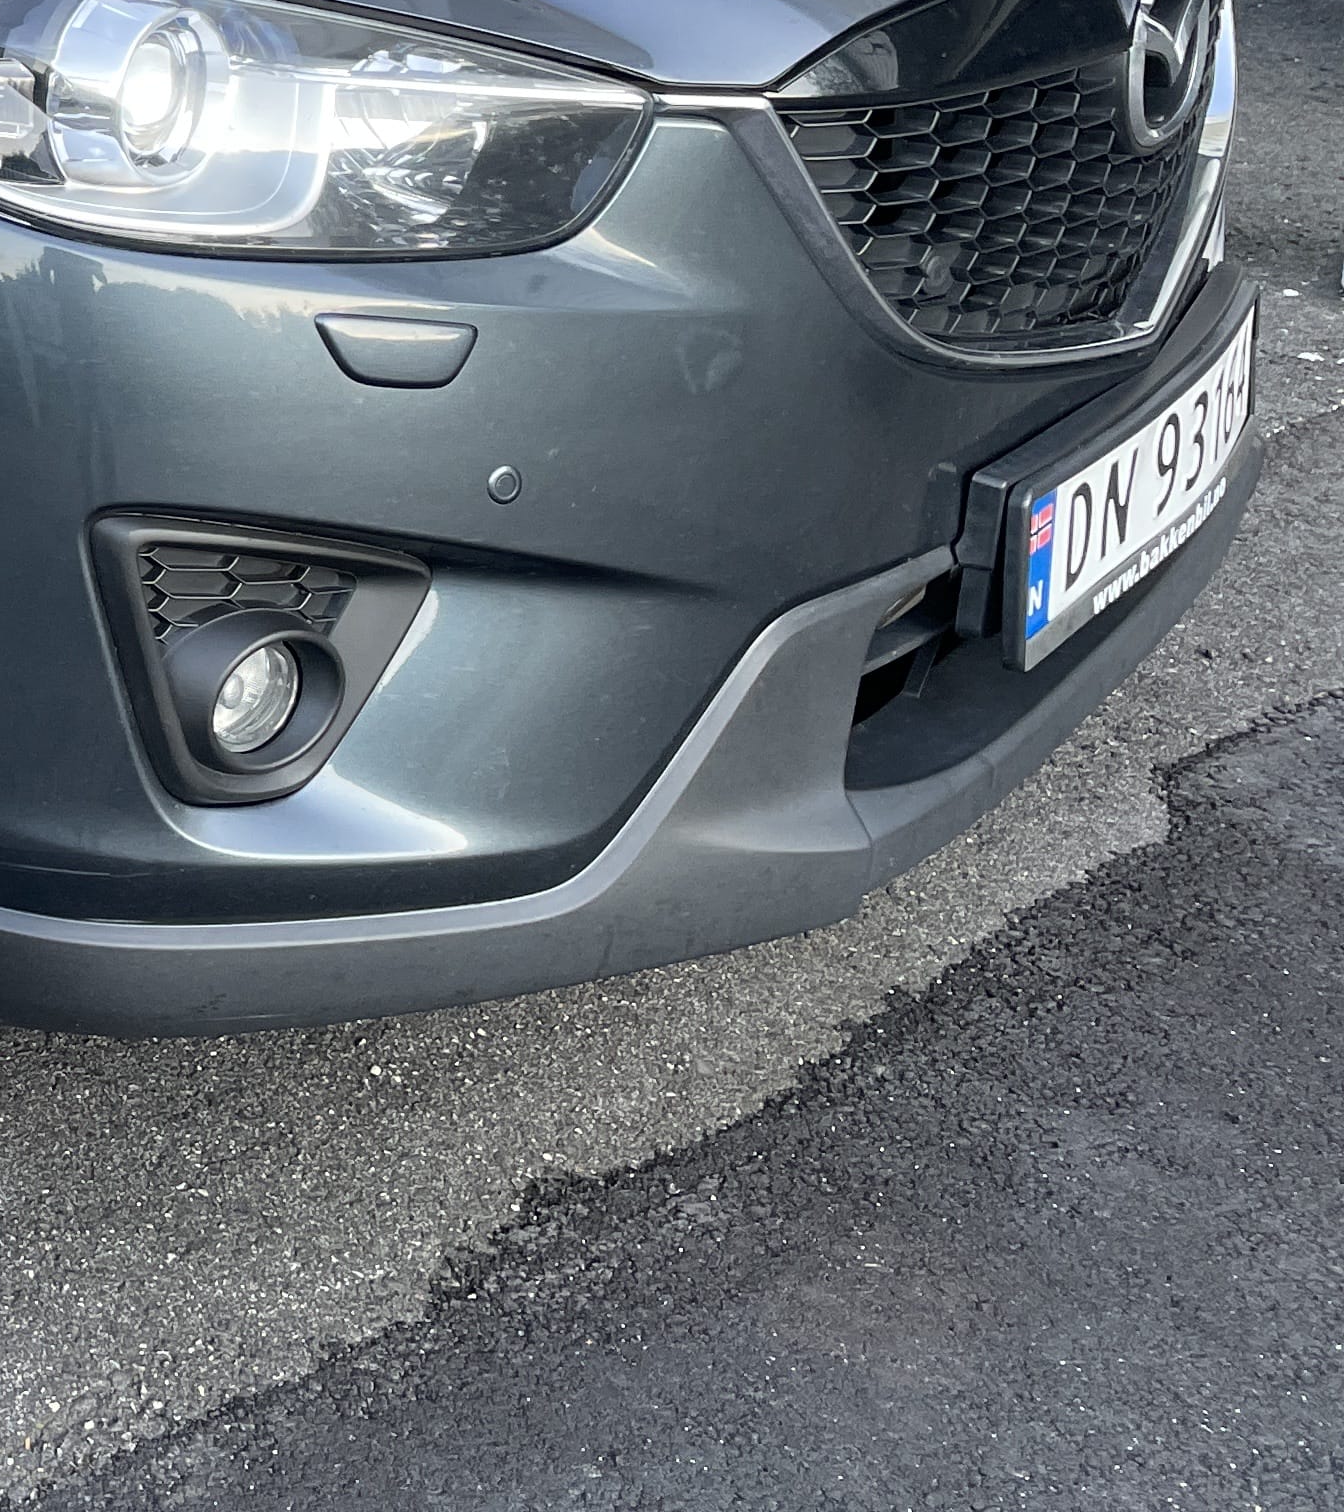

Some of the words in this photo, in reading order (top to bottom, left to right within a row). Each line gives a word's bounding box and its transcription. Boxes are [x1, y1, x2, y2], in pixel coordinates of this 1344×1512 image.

[1065, 447, 1139, 592] DN
[1156, 324, 1249, 517] 93164
[1028, 580, 1043, 616] N
[1093, 476, 1227, 615] www.bakkenbil.no
